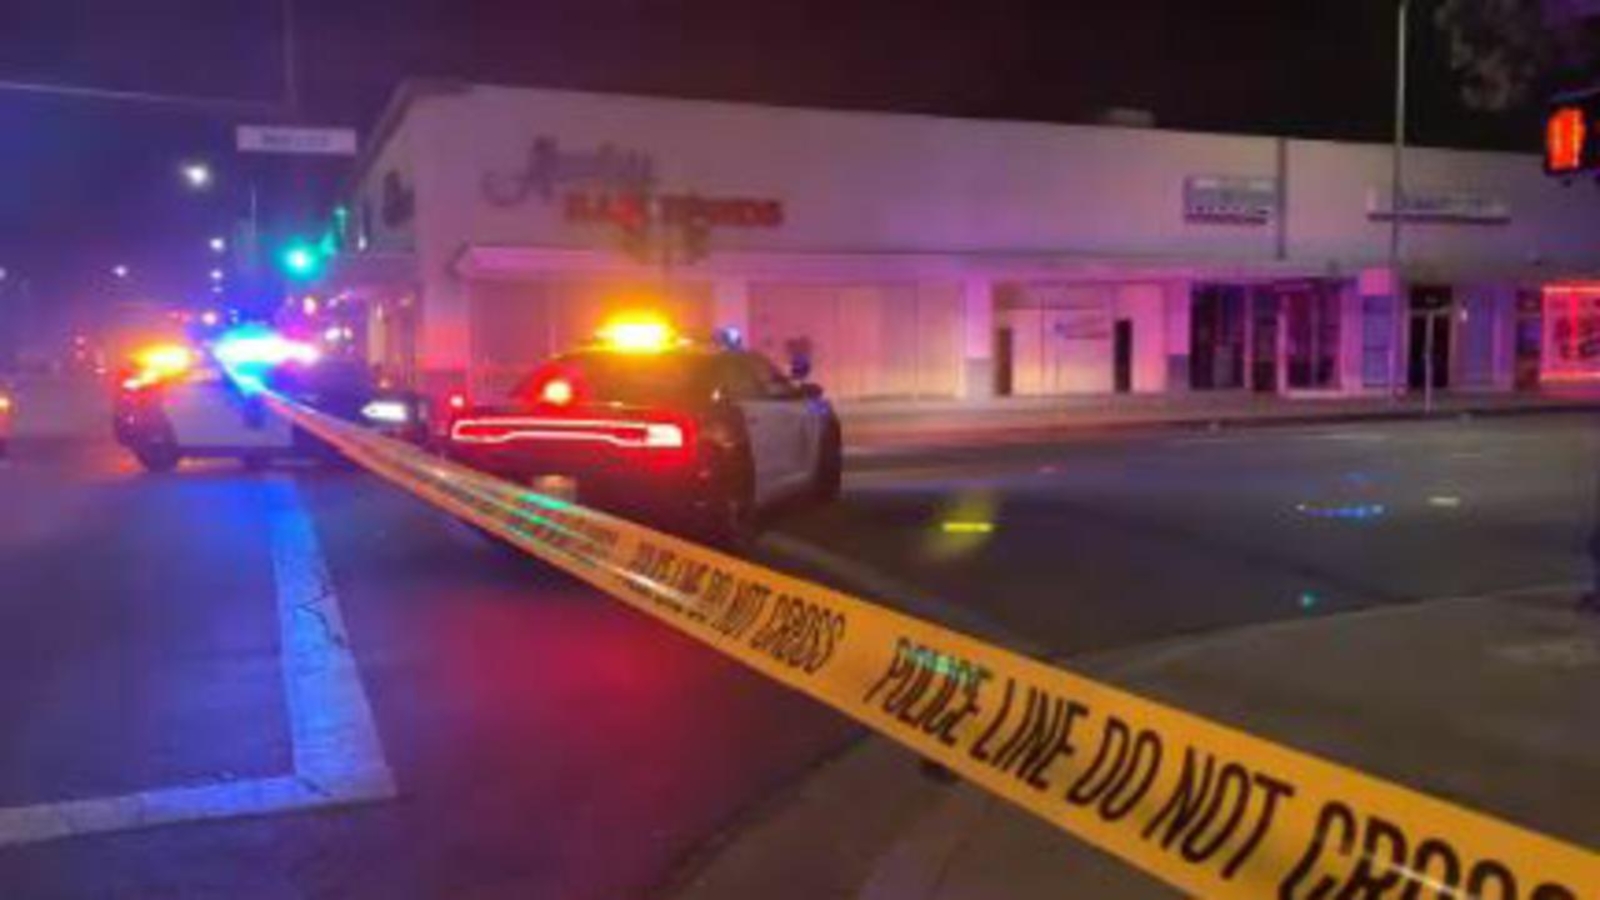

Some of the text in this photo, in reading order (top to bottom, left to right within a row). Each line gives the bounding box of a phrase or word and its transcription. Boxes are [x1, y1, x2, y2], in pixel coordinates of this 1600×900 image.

[863, 637, 992, 745] POLICE
[969, 677, 1089, 789] LINE
[1066, 715, 1162, 822] DO
[1141, 745, 1295, 879] NOT
